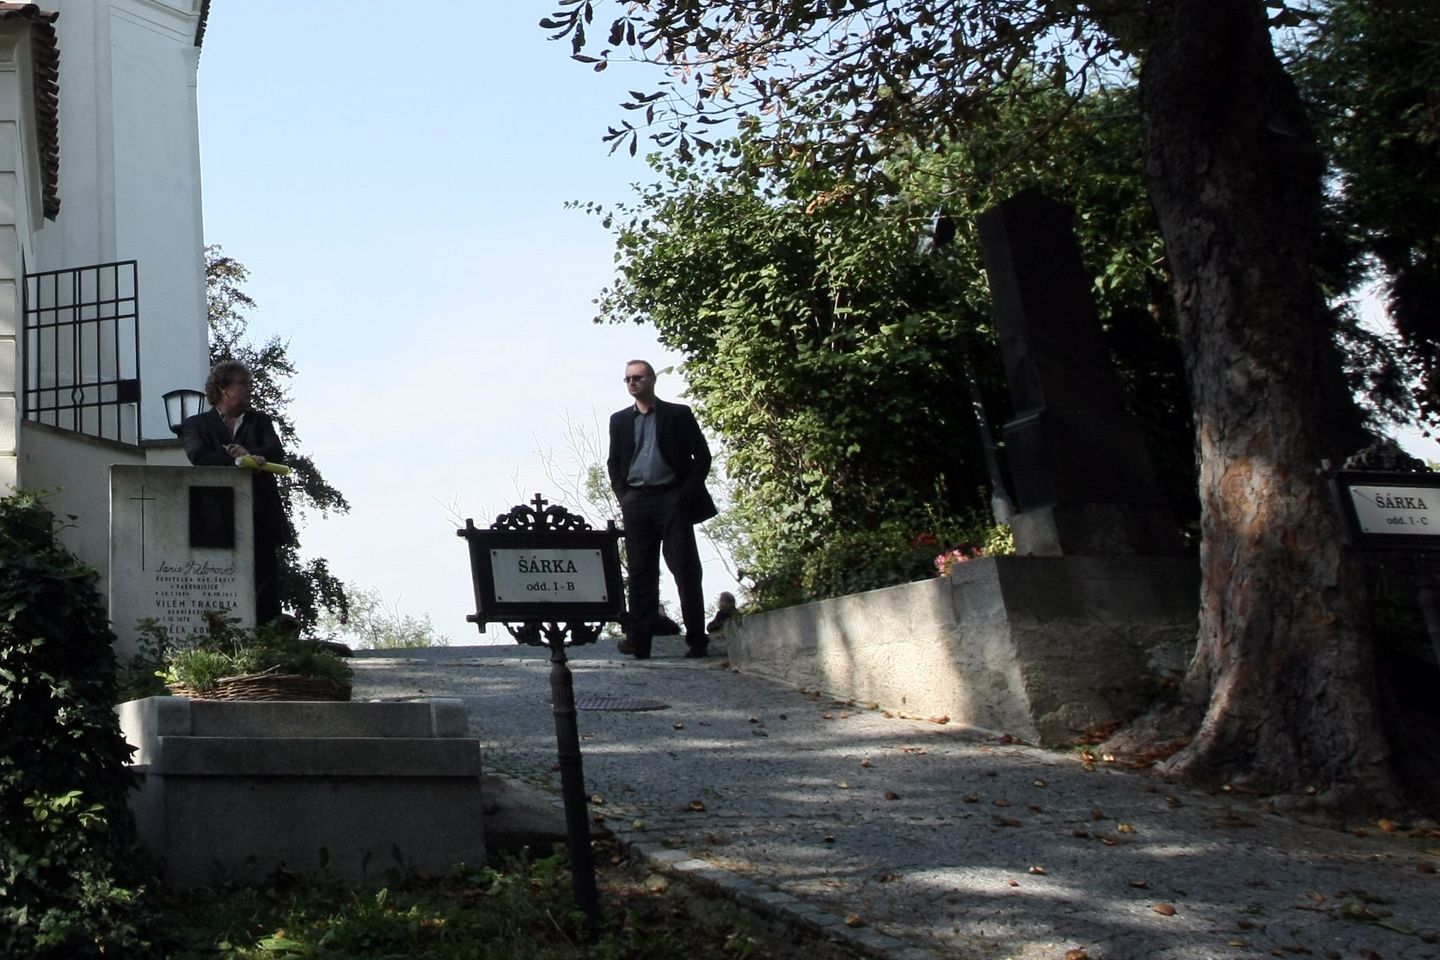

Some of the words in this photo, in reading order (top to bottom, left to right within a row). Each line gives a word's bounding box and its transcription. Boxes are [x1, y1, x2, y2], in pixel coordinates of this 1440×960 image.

[1375, 492, 1428, 510] ŠÁRKA
[518, 554, 578, 574] ŠÁRKA
[526, 581, 551, 591] odd.
[155, 597, 186, 608] VILÉM
